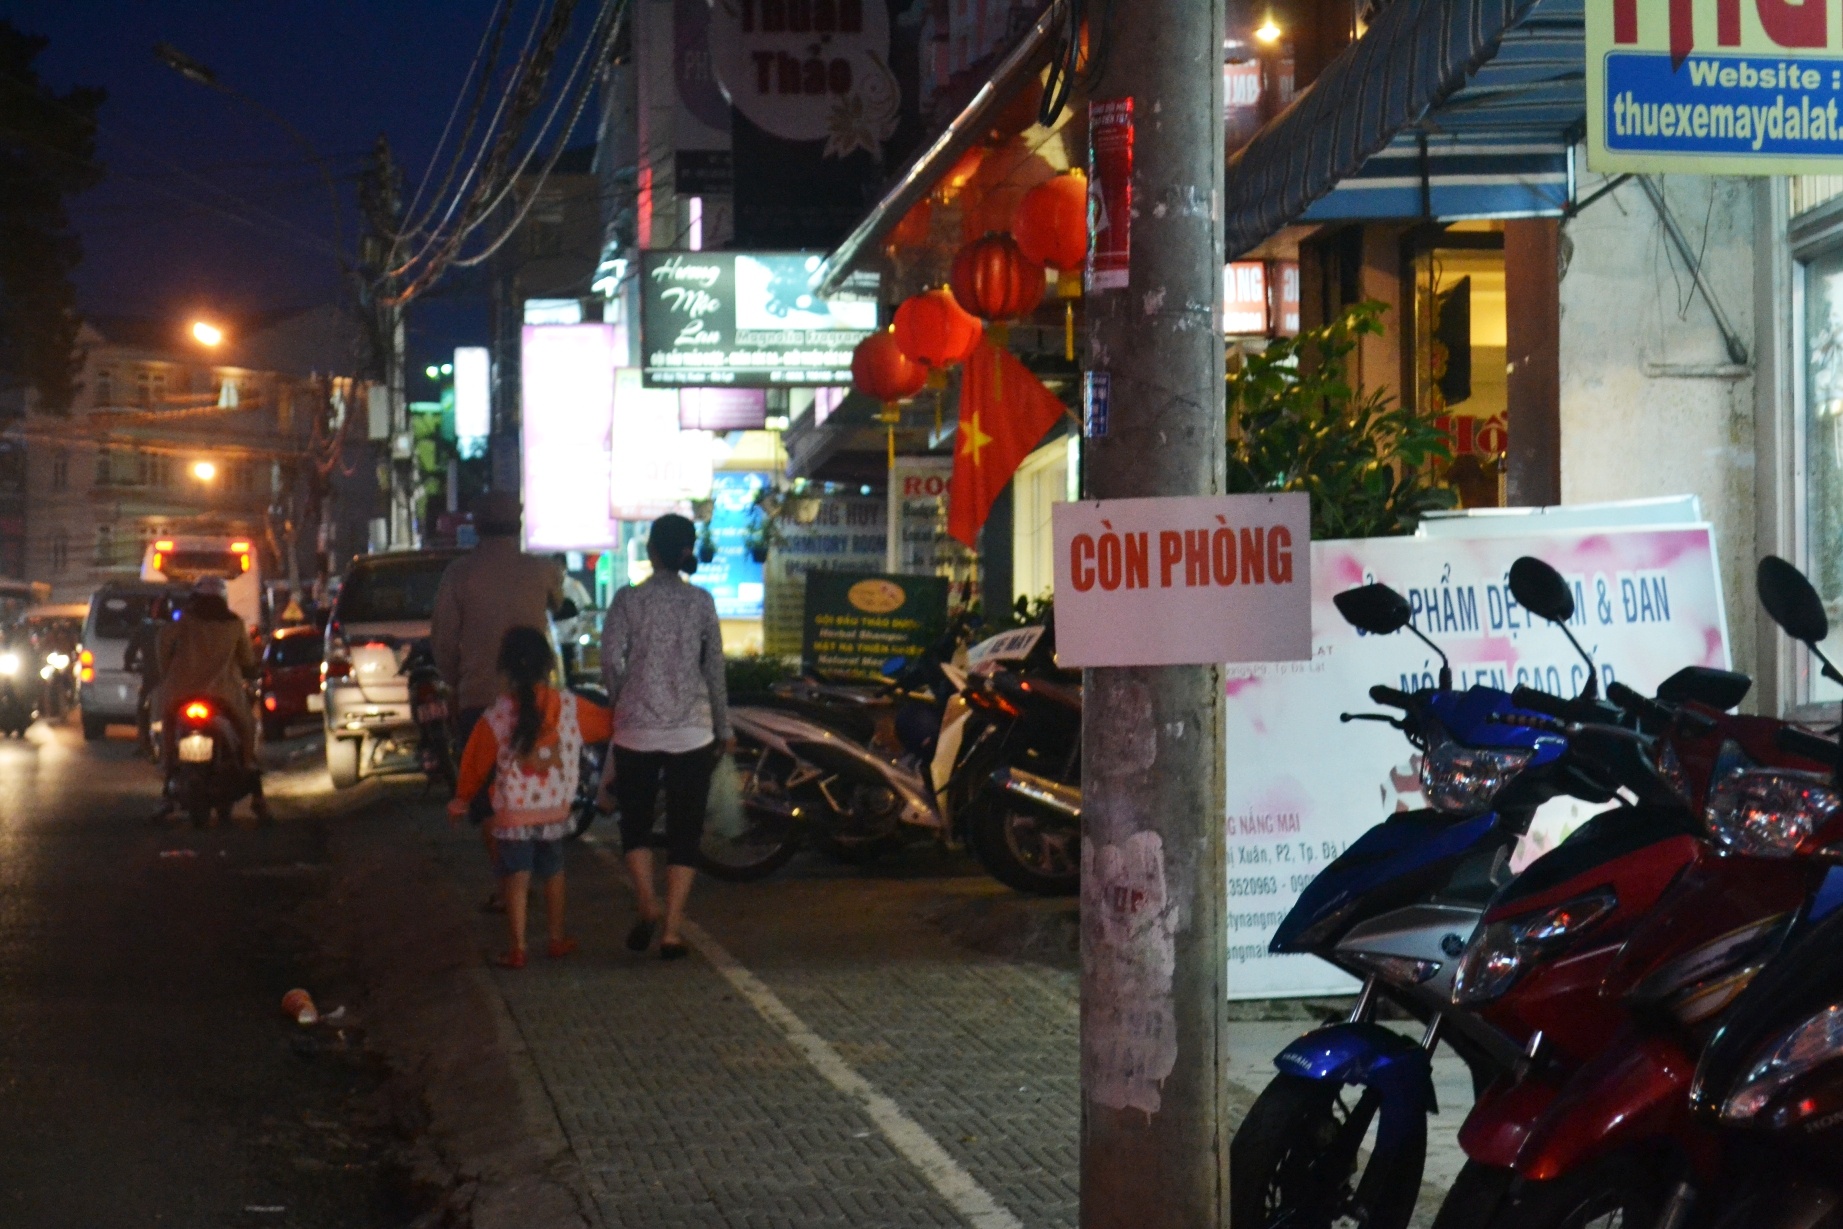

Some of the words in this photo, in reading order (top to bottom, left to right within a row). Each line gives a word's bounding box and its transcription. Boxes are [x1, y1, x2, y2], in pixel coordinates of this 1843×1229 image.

[1688, 60, 1821, 90] Website
[1071, 518, 1149, 593] CÒN
[1159, 514, 1293, 588] PHÒNG
[1408, 562, 1480, 633] PHẨM
[1596, 576, 1614, 626] &
[1621, 575, 1671, 624] ĐAN
[1239, 806, 1274, 835] NẮNG
[1277, 813, 1301, 833] MAI
